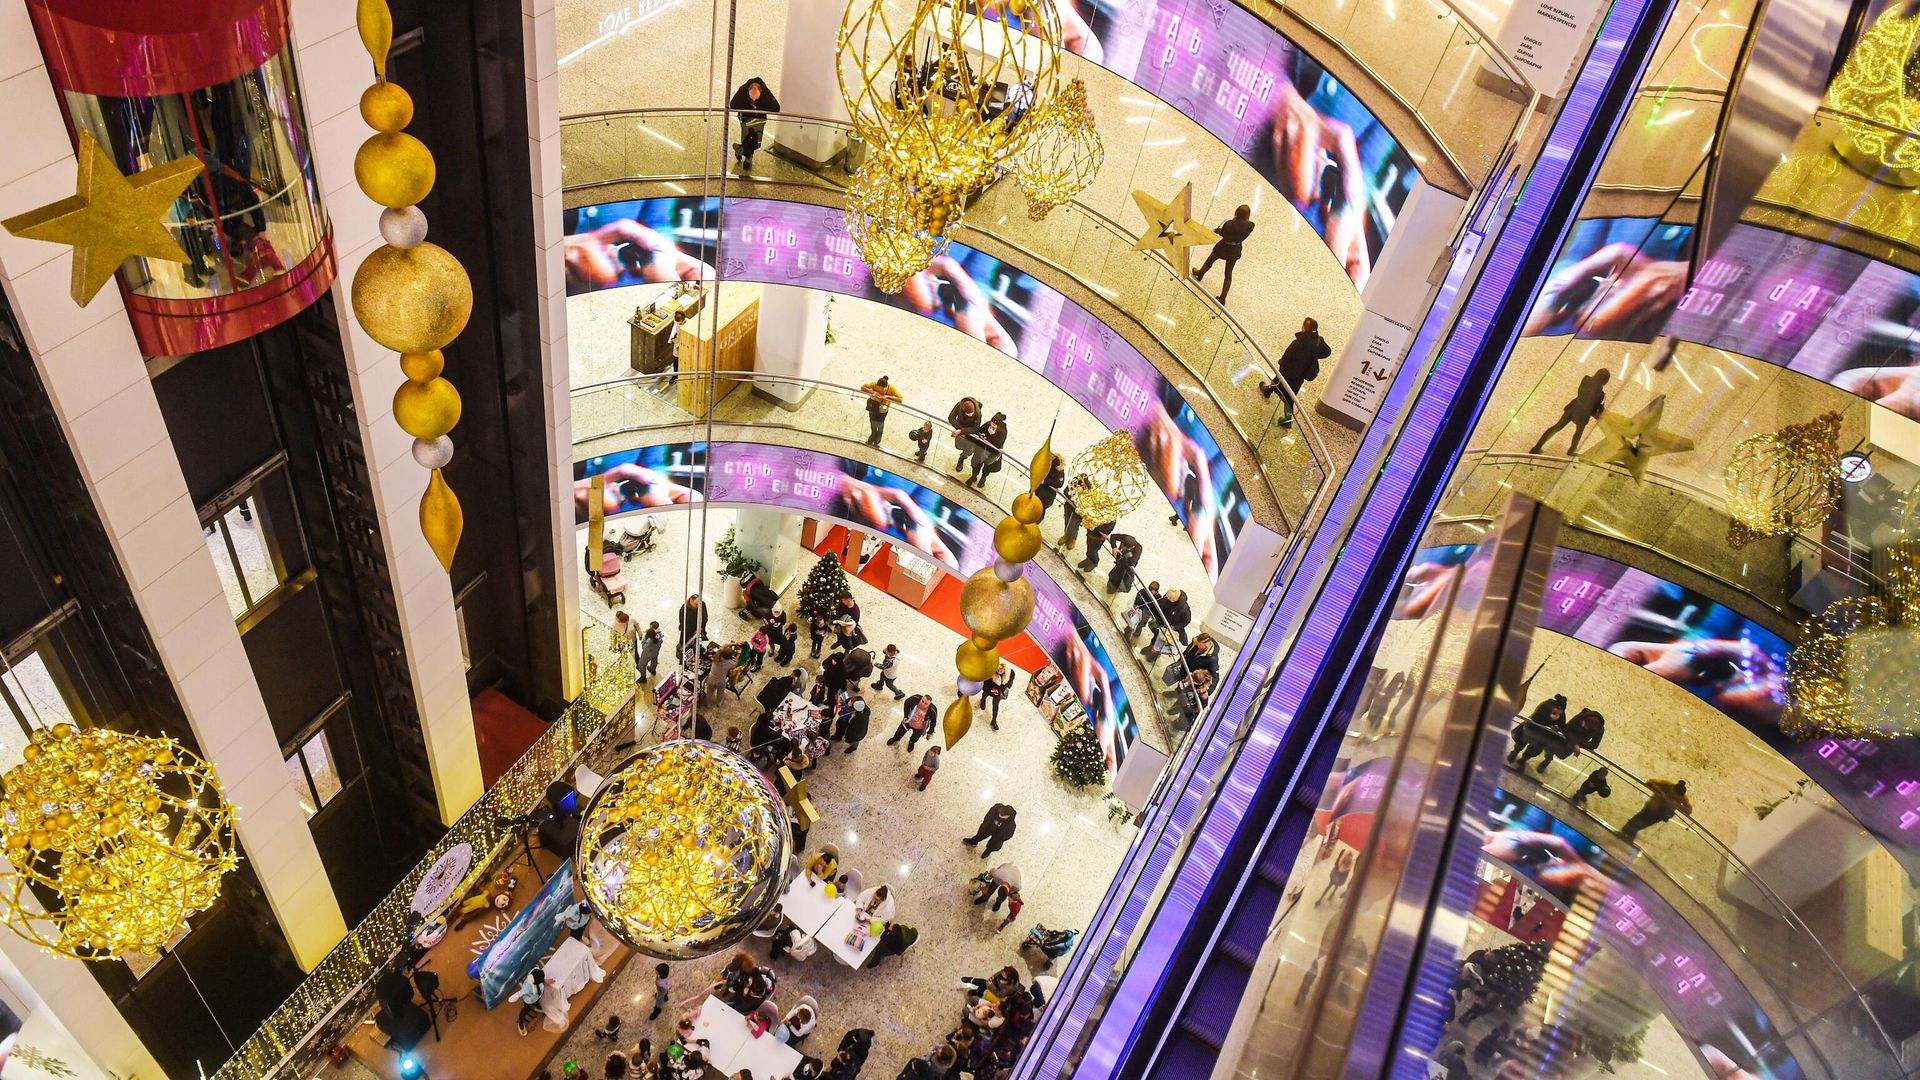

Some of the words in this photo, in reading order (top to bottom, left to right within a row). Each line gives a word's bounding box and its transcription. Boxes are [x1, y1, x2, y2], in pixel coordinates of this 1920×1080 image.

[1540, 2, 1554, 12] LOVE
[1553, 7, 1575, 20] REPUBLIC
[1520, 42, 1533, 51] ZARA
[1523, 35, 1542, 47] UNIQLO
[1227, 50, 1273, 103] ЧШЕЙ
[1361, 360, 1371, 375] 1
[1114, 367, 1149, 412] ЧШЕЙ
[795, 467, 836, 488] ЧШЕЙ
[1036, 591, 1065, 630] ЧШЕЙ
